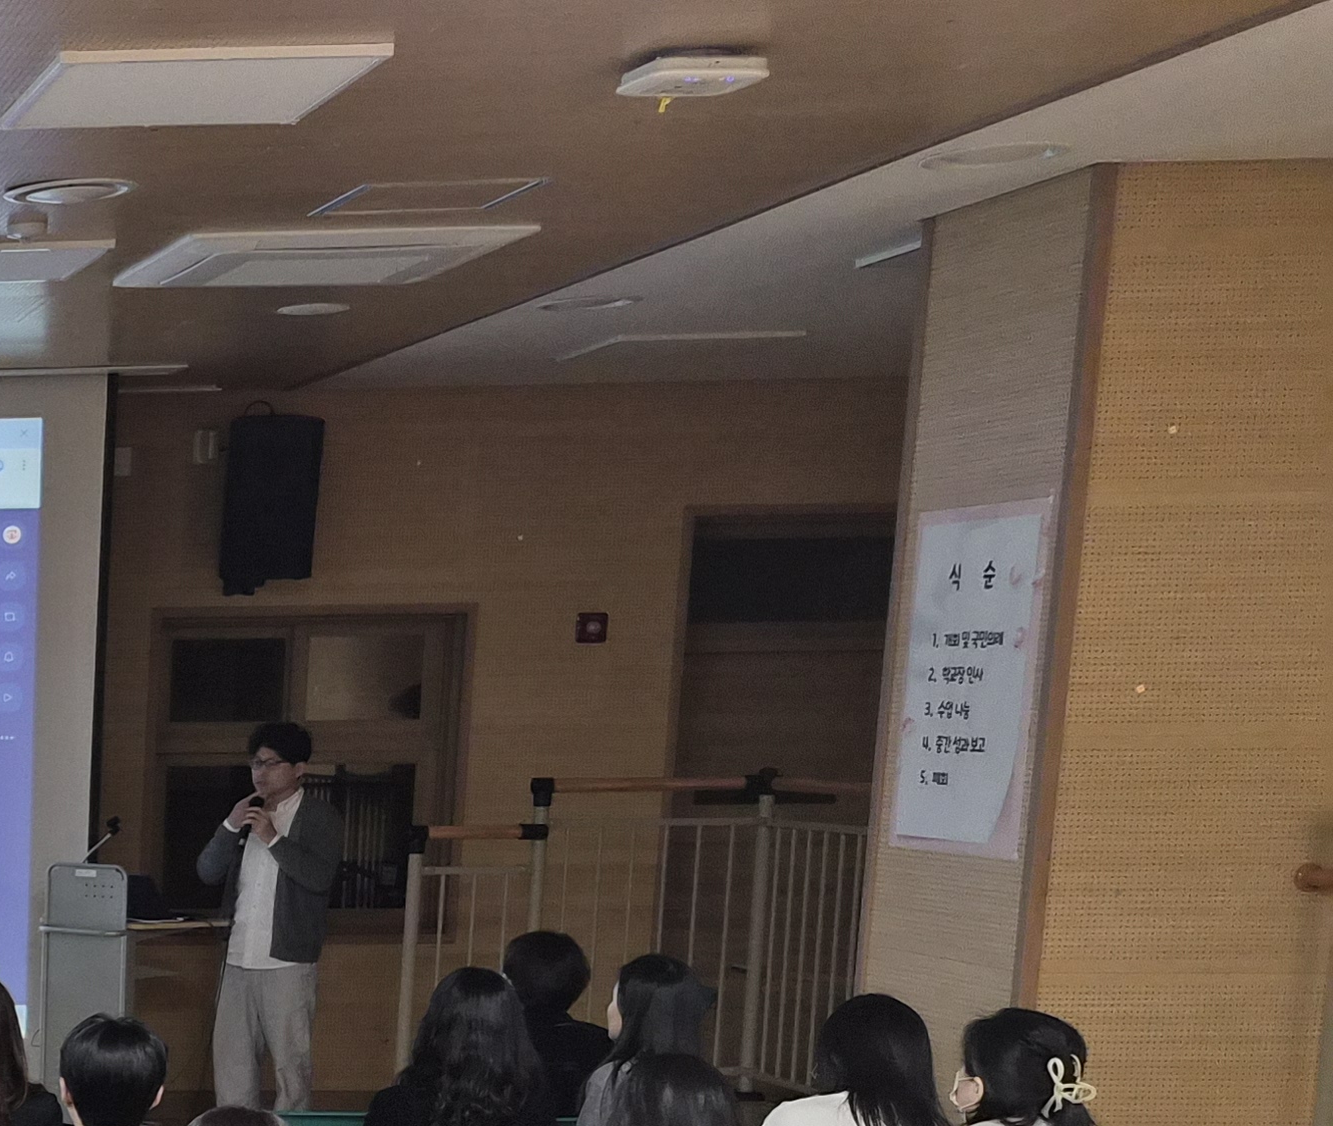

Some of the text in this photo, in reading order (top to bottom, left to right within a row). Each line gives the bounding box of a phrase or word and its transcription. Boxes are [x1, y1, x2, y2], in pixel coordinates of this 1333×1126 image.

[949, 560, 997, 591] 식 순
[932, 633, 939, 648] 1.
[928, 667, 937, 683] 2.
[966, 665, 984, 684] 인사
[924, 700, 970, 720] 3. 수업 나눔
[922, 736, 932, 751] 4.
[935, 735, 951, 754] 중간
[919, 770, 928, 785] 5.
